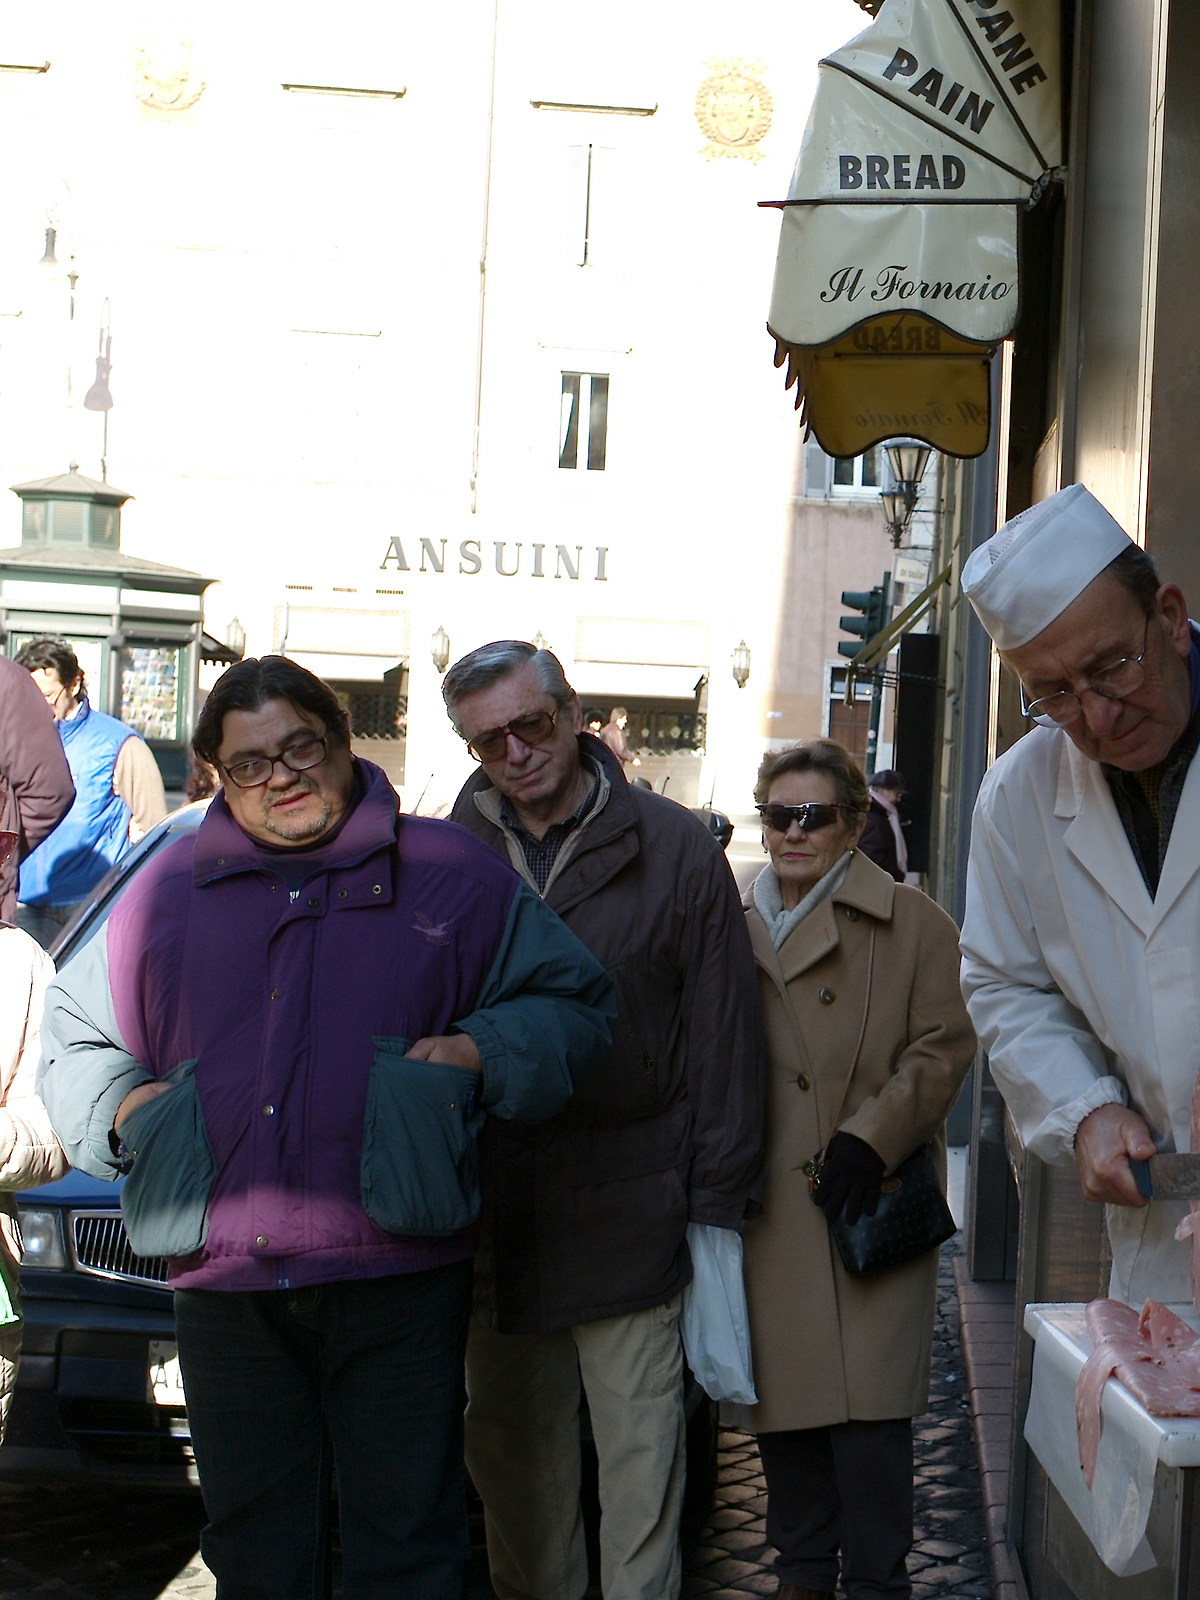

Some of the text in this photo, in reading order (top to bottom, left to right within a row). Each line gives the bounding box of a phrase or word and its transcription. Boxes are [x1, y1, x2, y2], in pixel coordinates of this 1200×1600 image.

[882, 47, 995, 134] PAIN
[838, 154, 966, 190] BREAD
[820, 265, 1014, 302] Il Fornaio
[379, 536, 609, 581] ANSUINI
